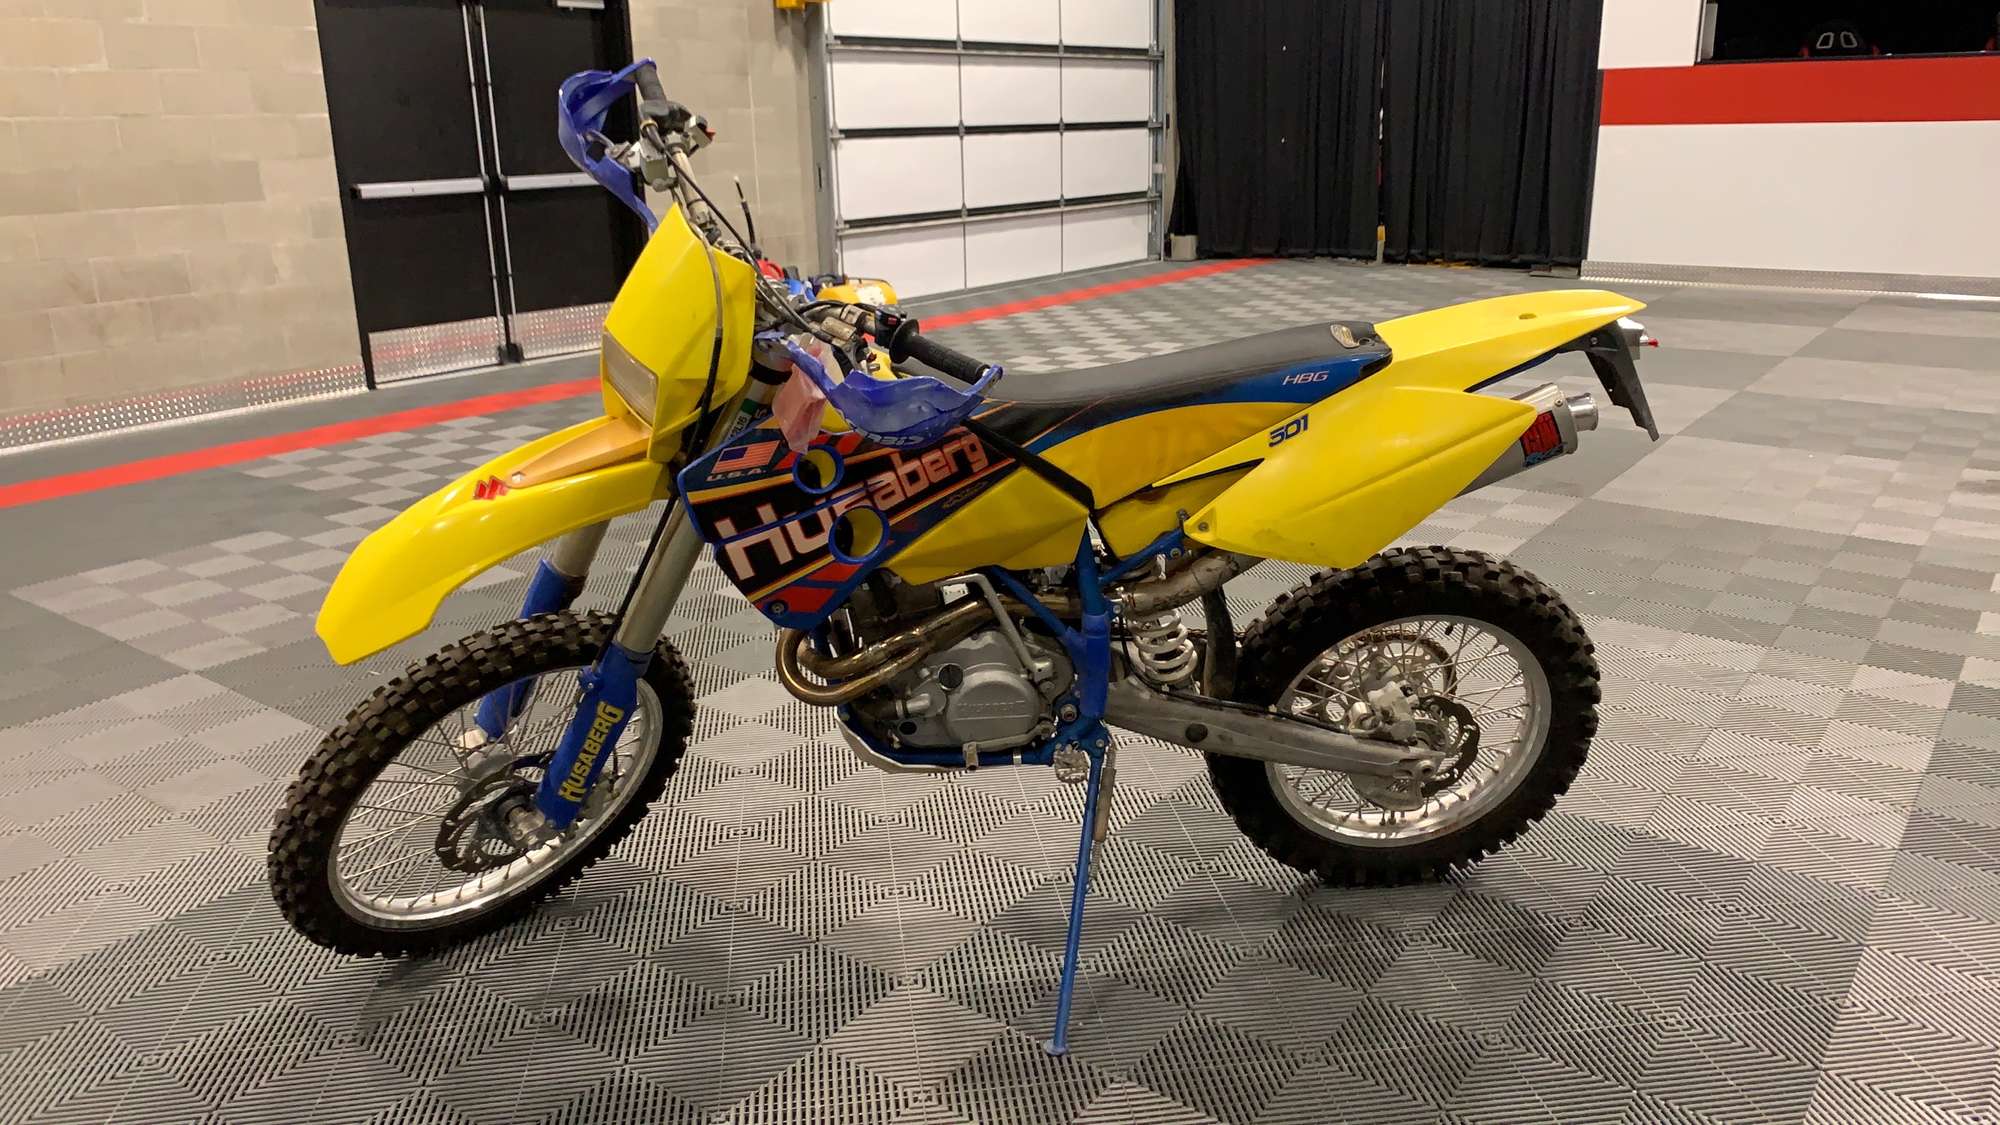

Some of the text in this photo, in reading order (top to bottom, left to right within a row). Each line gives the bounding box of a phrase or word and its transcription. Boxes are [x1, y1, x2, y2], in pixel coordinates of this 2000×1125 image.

[1282, 370, 1329, 386] HBG
[1269, 413, 1308, 447] 501
[559, 700, 625, 802] HUSABERG
